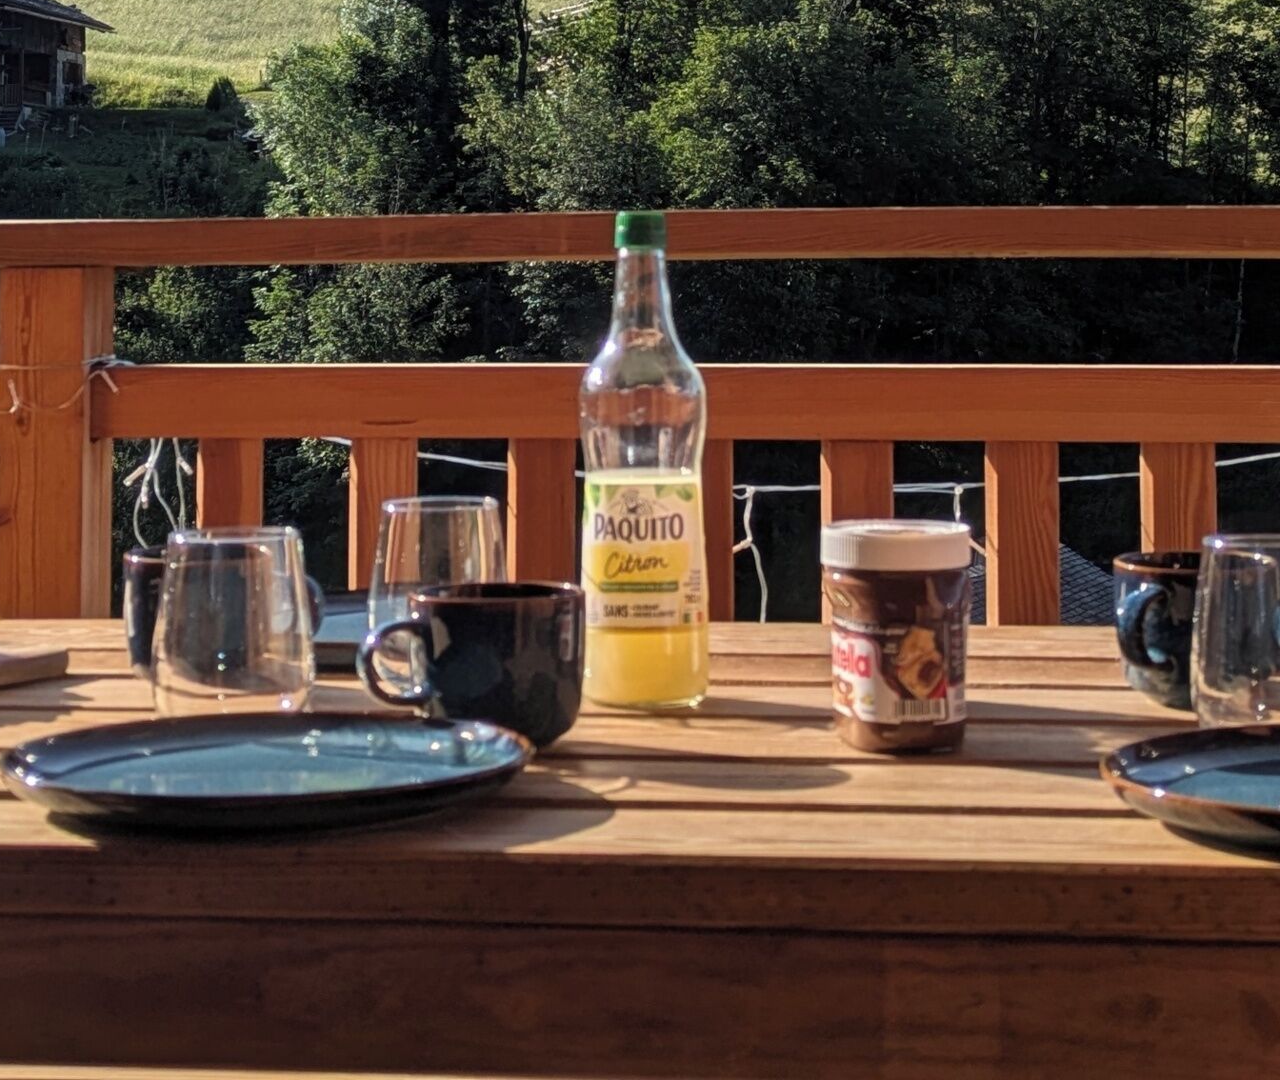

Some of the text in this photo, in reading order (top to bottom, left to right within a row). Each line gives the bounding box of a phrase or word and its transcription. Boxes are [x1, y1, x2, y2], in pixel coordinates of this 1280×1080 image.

[594, 512, 685, 544] PAQUITO
[604, 551, 669, 580] Citron
[603, 604, 628, 618] SANS
[832, 642, 871, 679] tella
